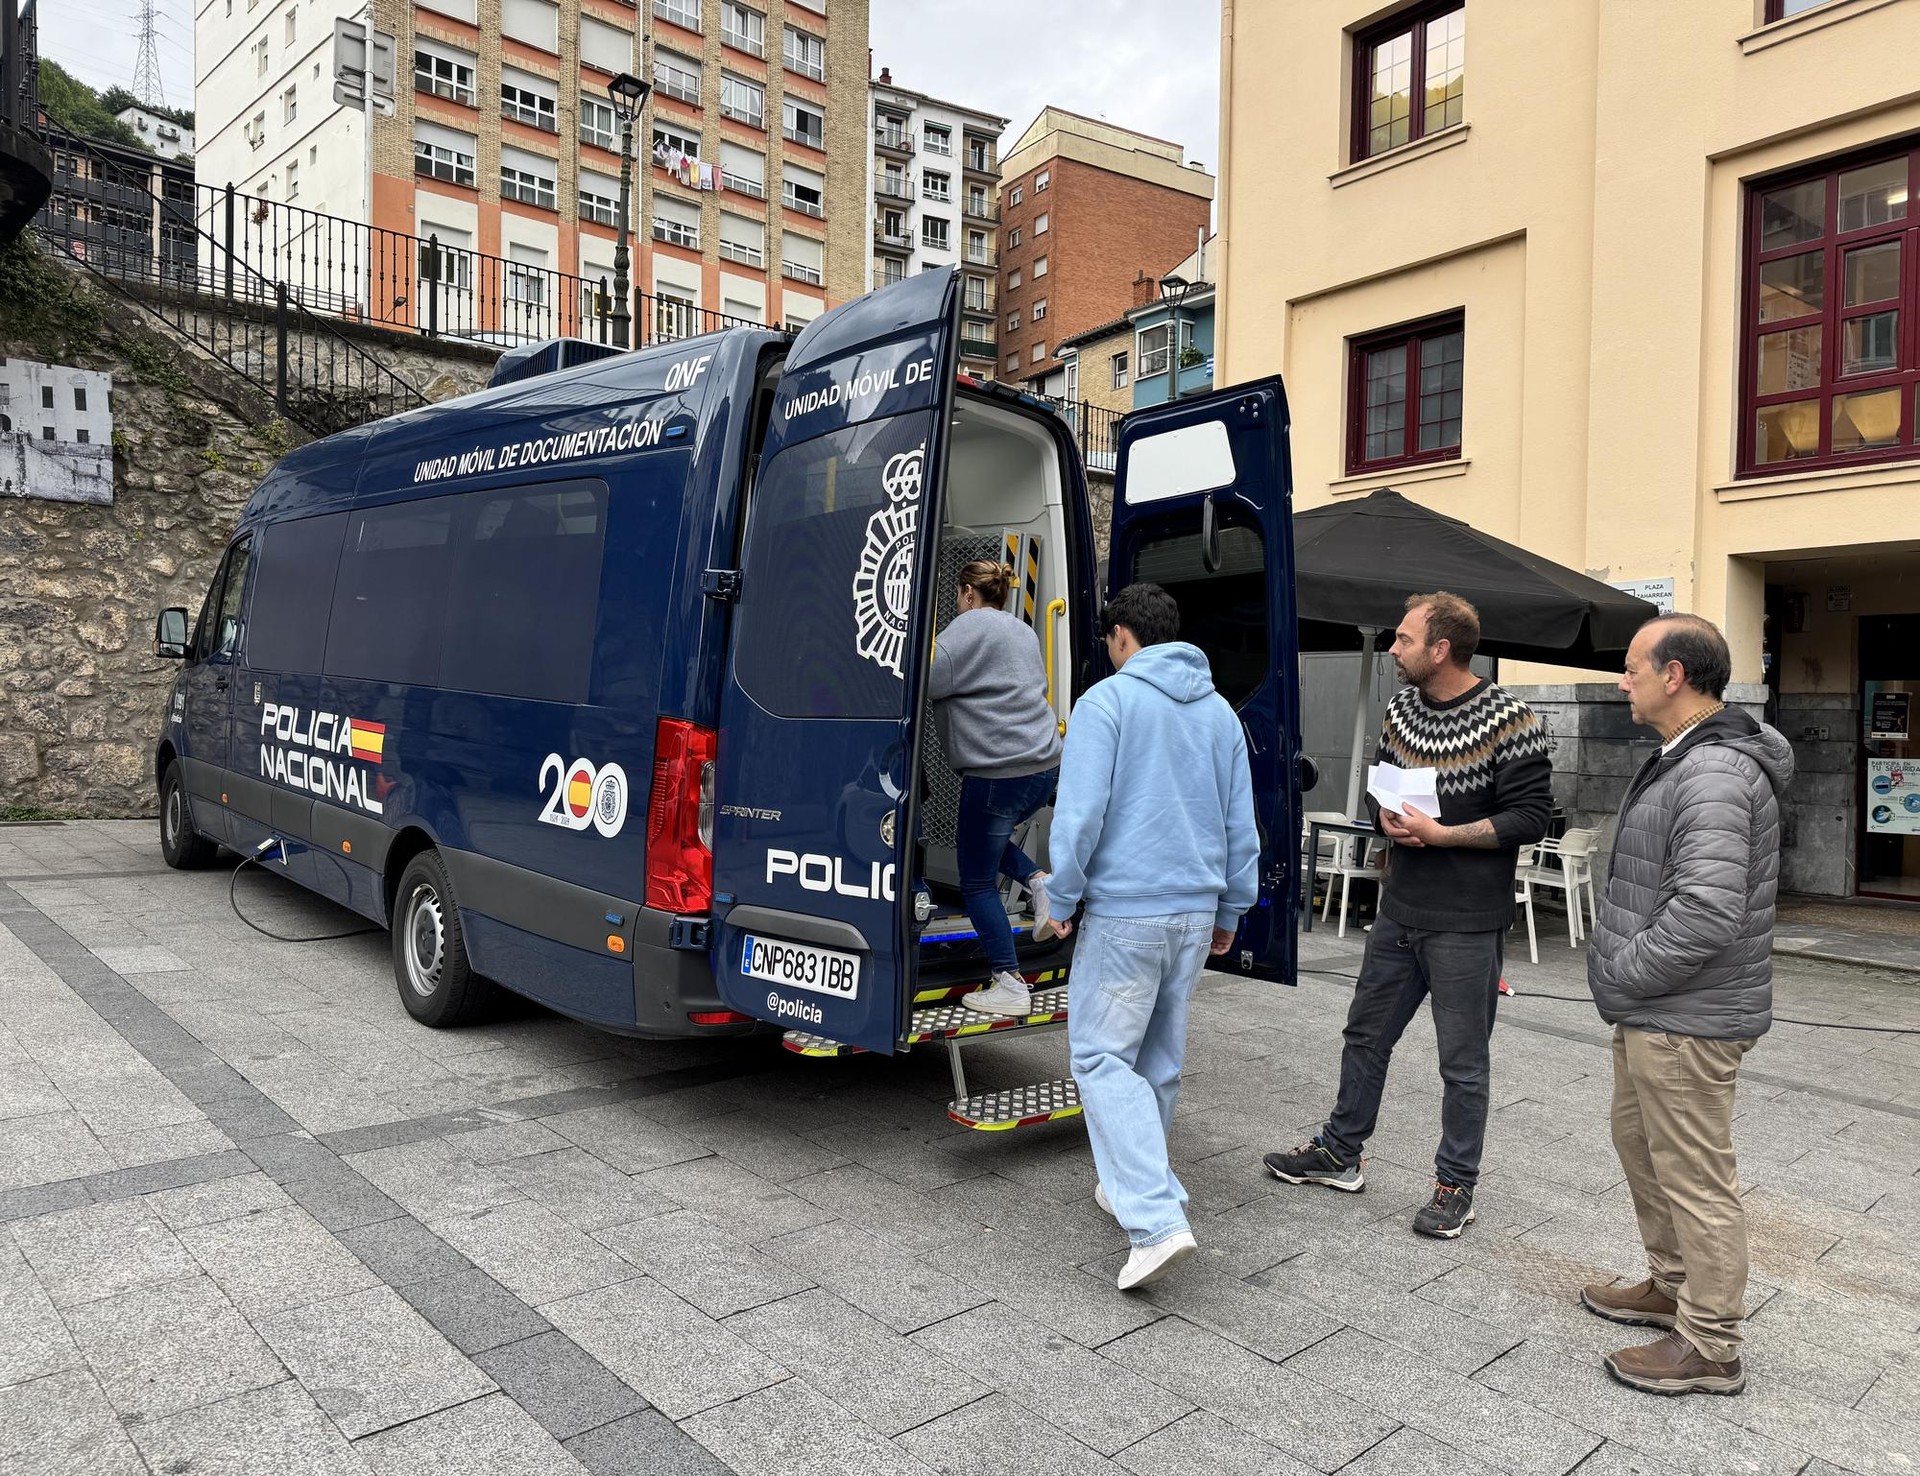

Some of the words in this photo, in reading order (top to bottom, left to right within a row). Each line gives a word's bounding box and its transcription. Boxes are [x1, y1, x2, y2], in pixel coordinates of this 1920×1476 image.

[664, 354, 712, 392] ONF
[784, 384, 841, 420] UNIDAD
[844, 368, 900, 401] MÓVIL
[904, 358, 934, 385] DE
[414, 456, 457, 483] UNIDAD
[457, 445, 496, 475] MÓVIL
[498, 443, 521, 469] DE
[519, 413, 664, 466] DOCUMENTACIÓN
[260, 743, 383, 815] NACIONAL
[538, 752, 628, 838] 200
[719, 804, 782, 821] SPRINTER
[752, 942, 855, 992] CNP6831BB
[766, 991, 823, 1025] @policia
